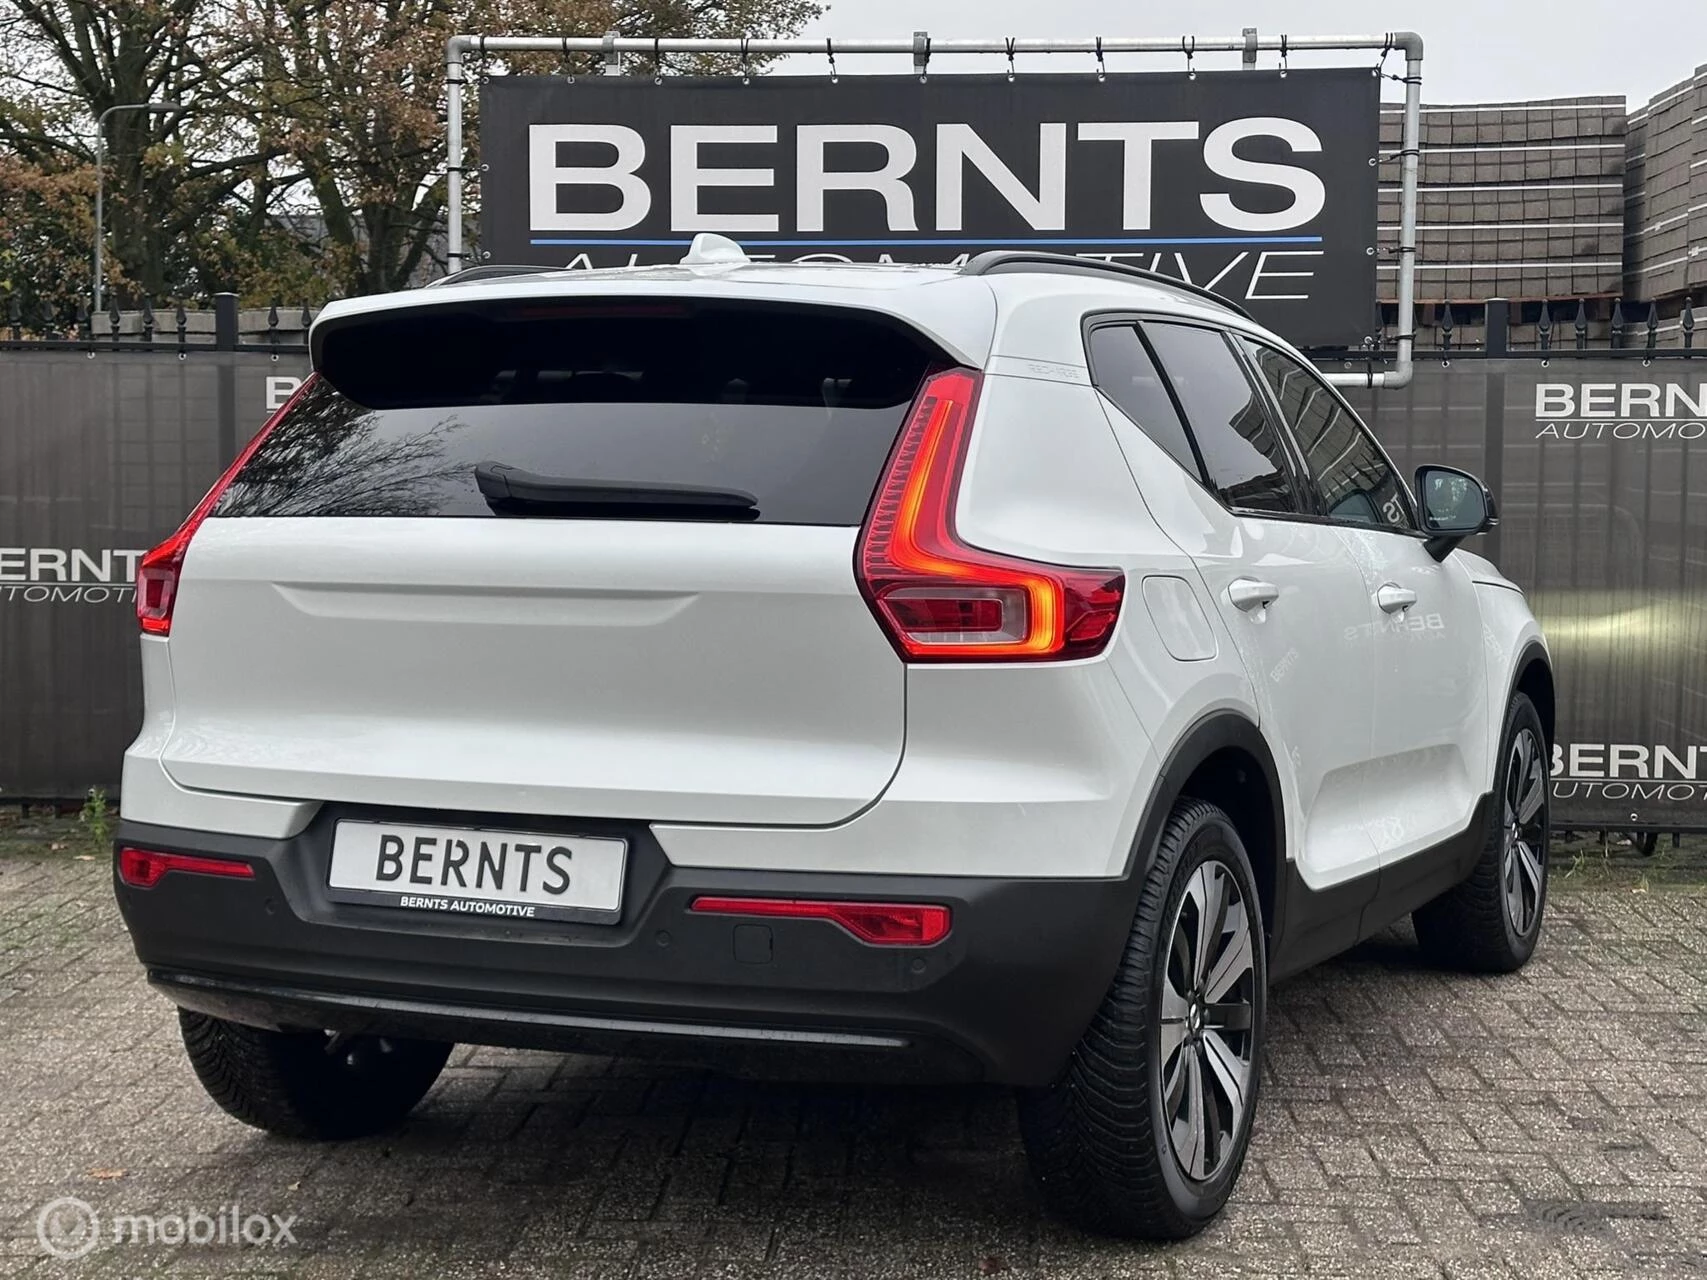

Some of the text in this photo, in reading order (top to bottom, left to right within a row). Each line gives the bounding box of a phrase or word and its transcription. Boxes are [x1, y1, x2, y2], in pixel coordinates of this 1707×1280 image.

[529, 116, 1326, 233] BERNTS
[1550, 743, 1707, 779] ERN
[376, 834, 573, 895] BERNTS
[400, 897, 536, 918] BERNTS AUTOMOTIVE
